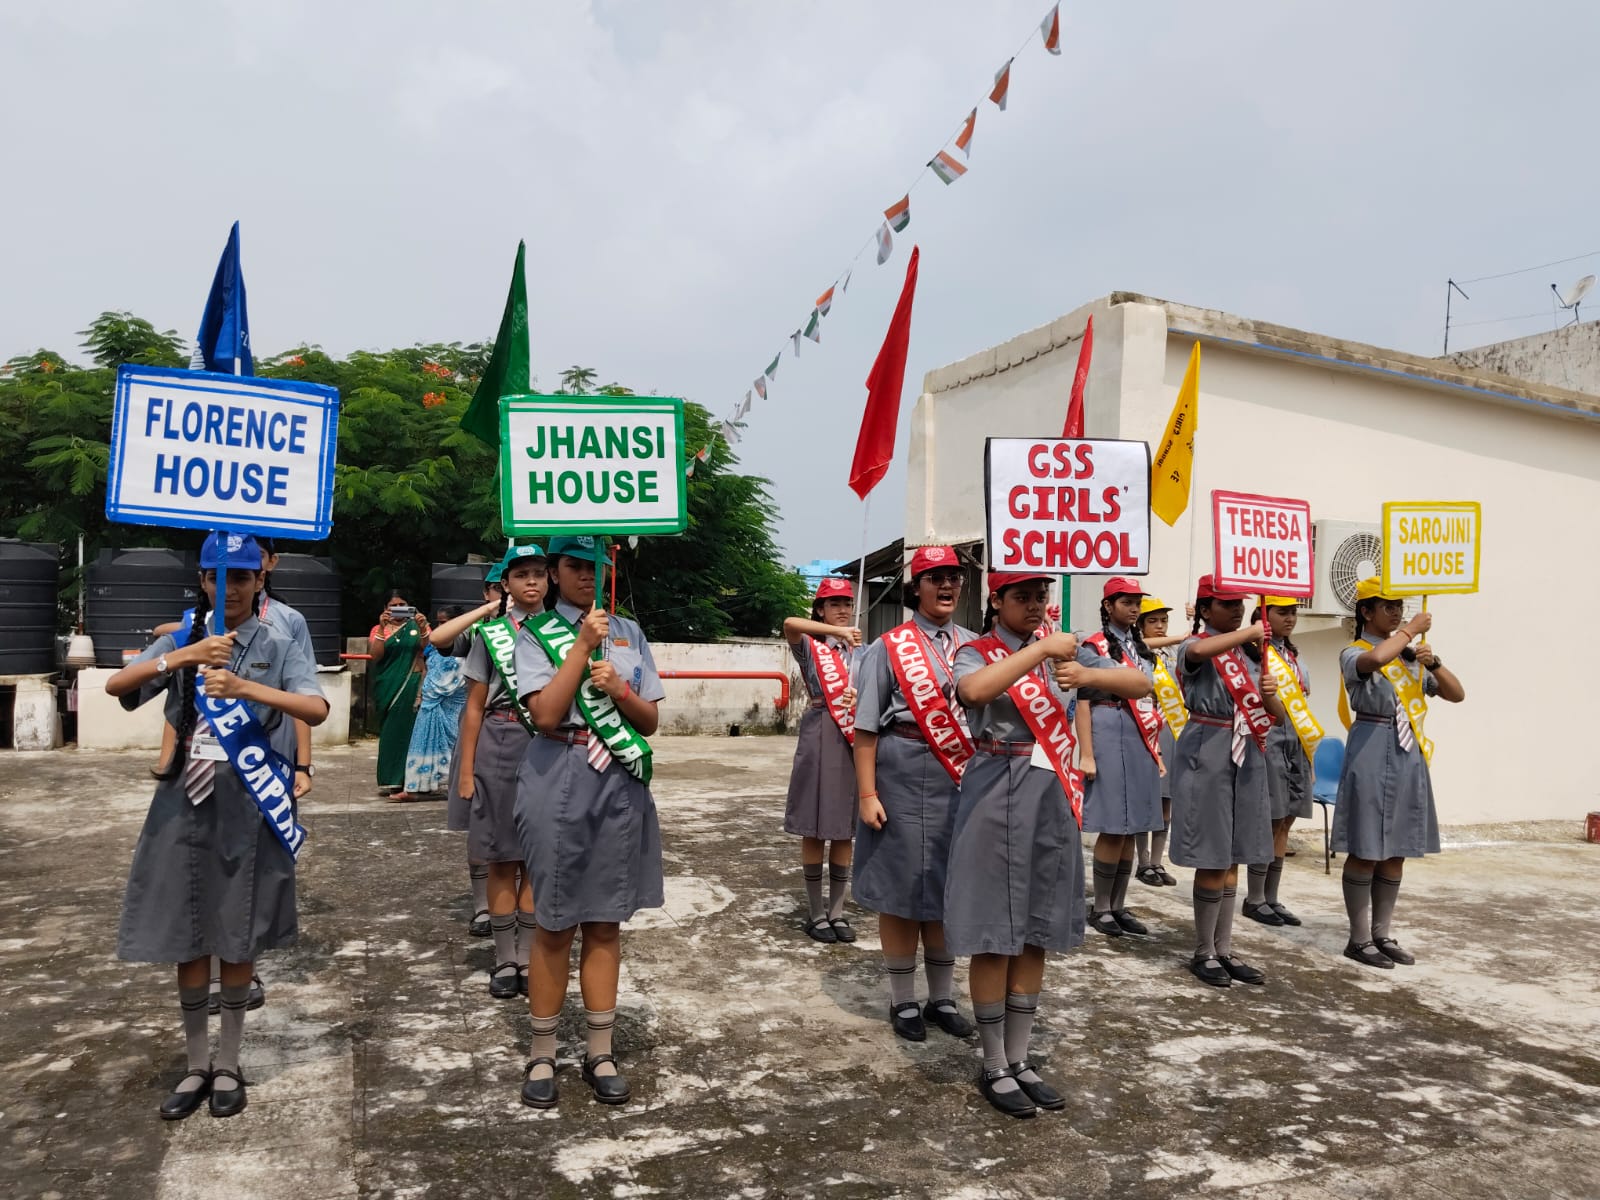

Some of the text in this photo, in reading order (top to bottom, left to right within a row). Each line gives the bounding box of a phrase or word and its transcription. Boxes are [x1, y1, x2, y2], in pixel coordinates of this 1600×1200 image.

[145, 397, 308, 454] FLORENCE
[525, 425, 665, 460] JHANSI
[153, 453, 289, 506] HOUSE
[528, 470, 660, 504] HOUSE
[1226, 506, 1303, 542] TERESA
[1398, 516, 1471, 545] SAROJINI
[1002, 528, 1139, 569] SCHOOL
[1232, 545, 1299, 579] HOUSE
[1402, 551, 1465, 576] HOUSE
[538, 617, 592, 666] VIC
[889, 629, 939, 710] SCHOOL
[988, 648, 1056, 728] SOOL
[1217, 654, 1247, 690] ICE
[1267, 649, 1320, 744] OUSE CAPT
